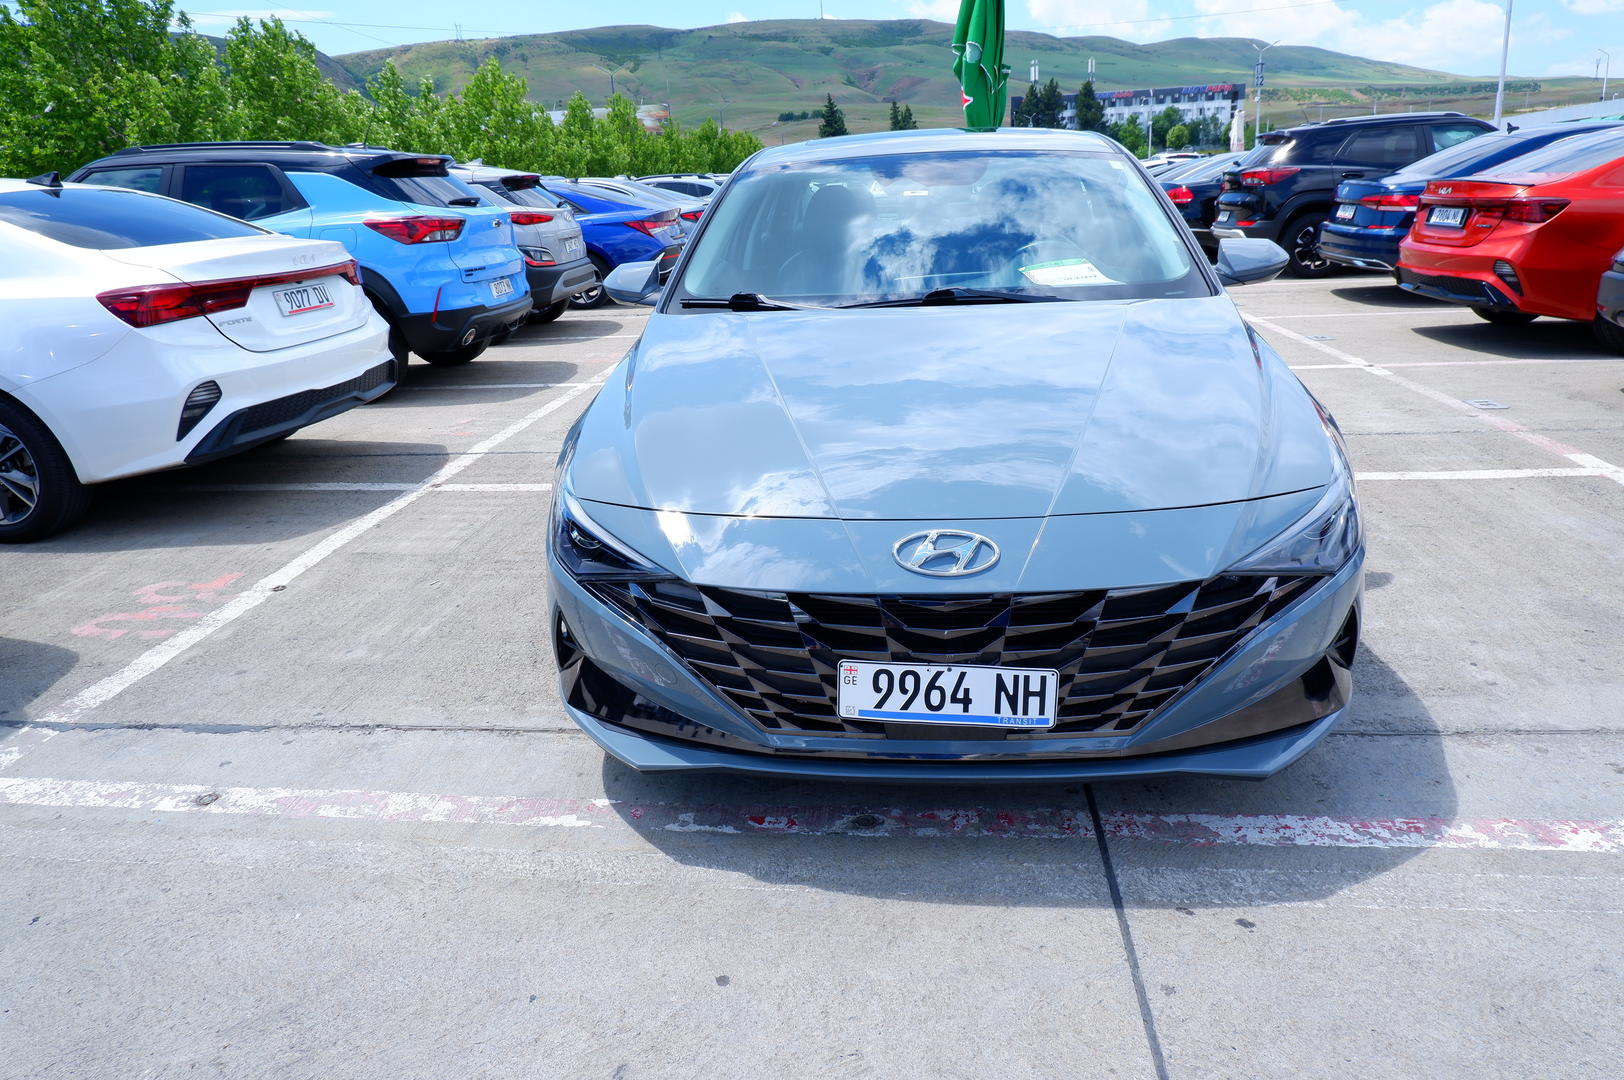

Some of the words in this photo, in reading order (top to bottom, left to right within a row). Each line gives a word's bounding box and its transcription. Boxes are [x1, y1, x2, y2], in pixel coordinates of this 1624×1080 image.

[284, 289, 311, 309] 9077
[312, 286, 330, 304] DV
[844, 676, 857, 685] GE
[872, 668, 972, 713] 9964
[994, 673, 1047, 716] NH
[998, 717, 1037, 725] TRANSIT
